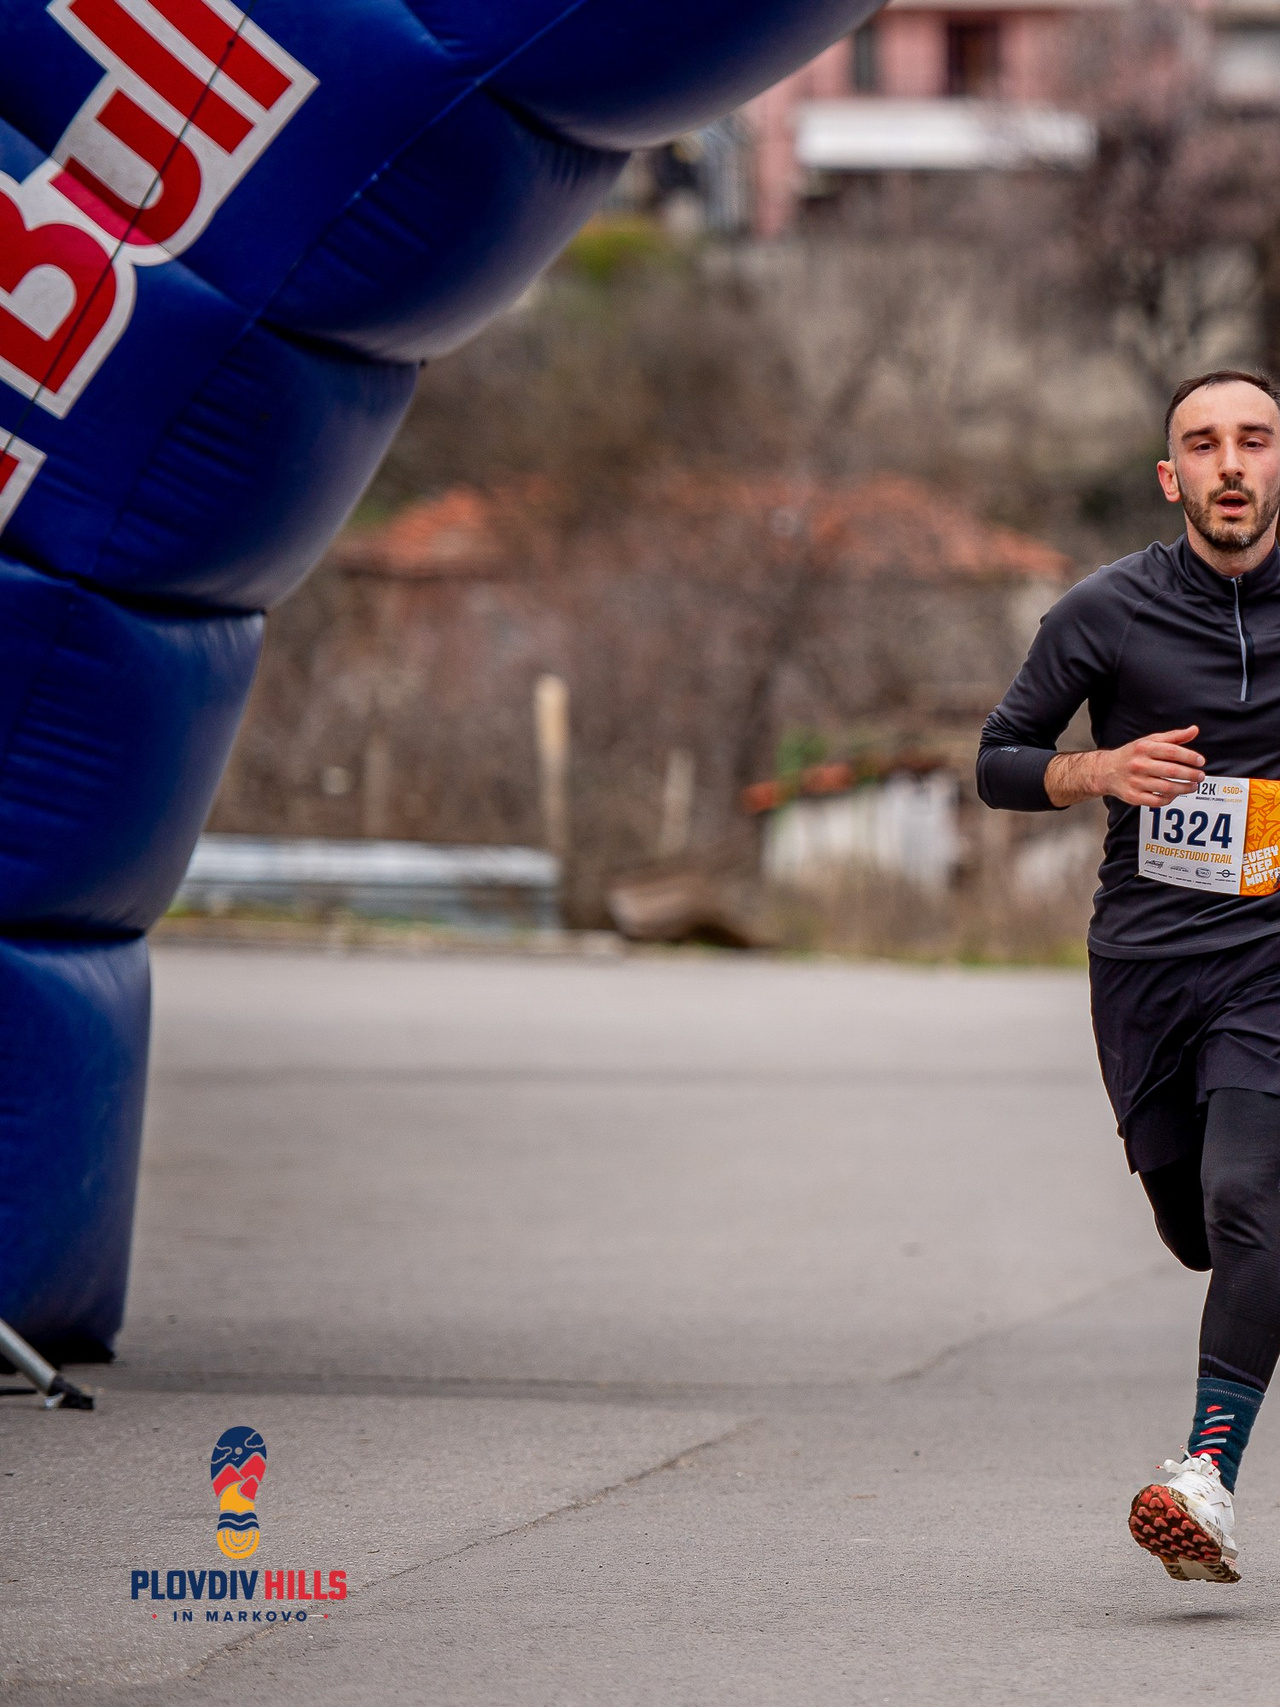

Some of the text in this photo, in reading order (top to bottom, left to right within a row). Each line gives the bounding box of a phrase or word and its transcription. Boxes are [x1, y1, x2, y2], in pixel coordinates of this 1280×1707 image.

[1196, 782, 1217, 796] 12K
[1149, 808, 1232, 848] 1324
[1211, 853, 1233, 865] TRAIL
[1243, 858, 1273, 876] STEP
